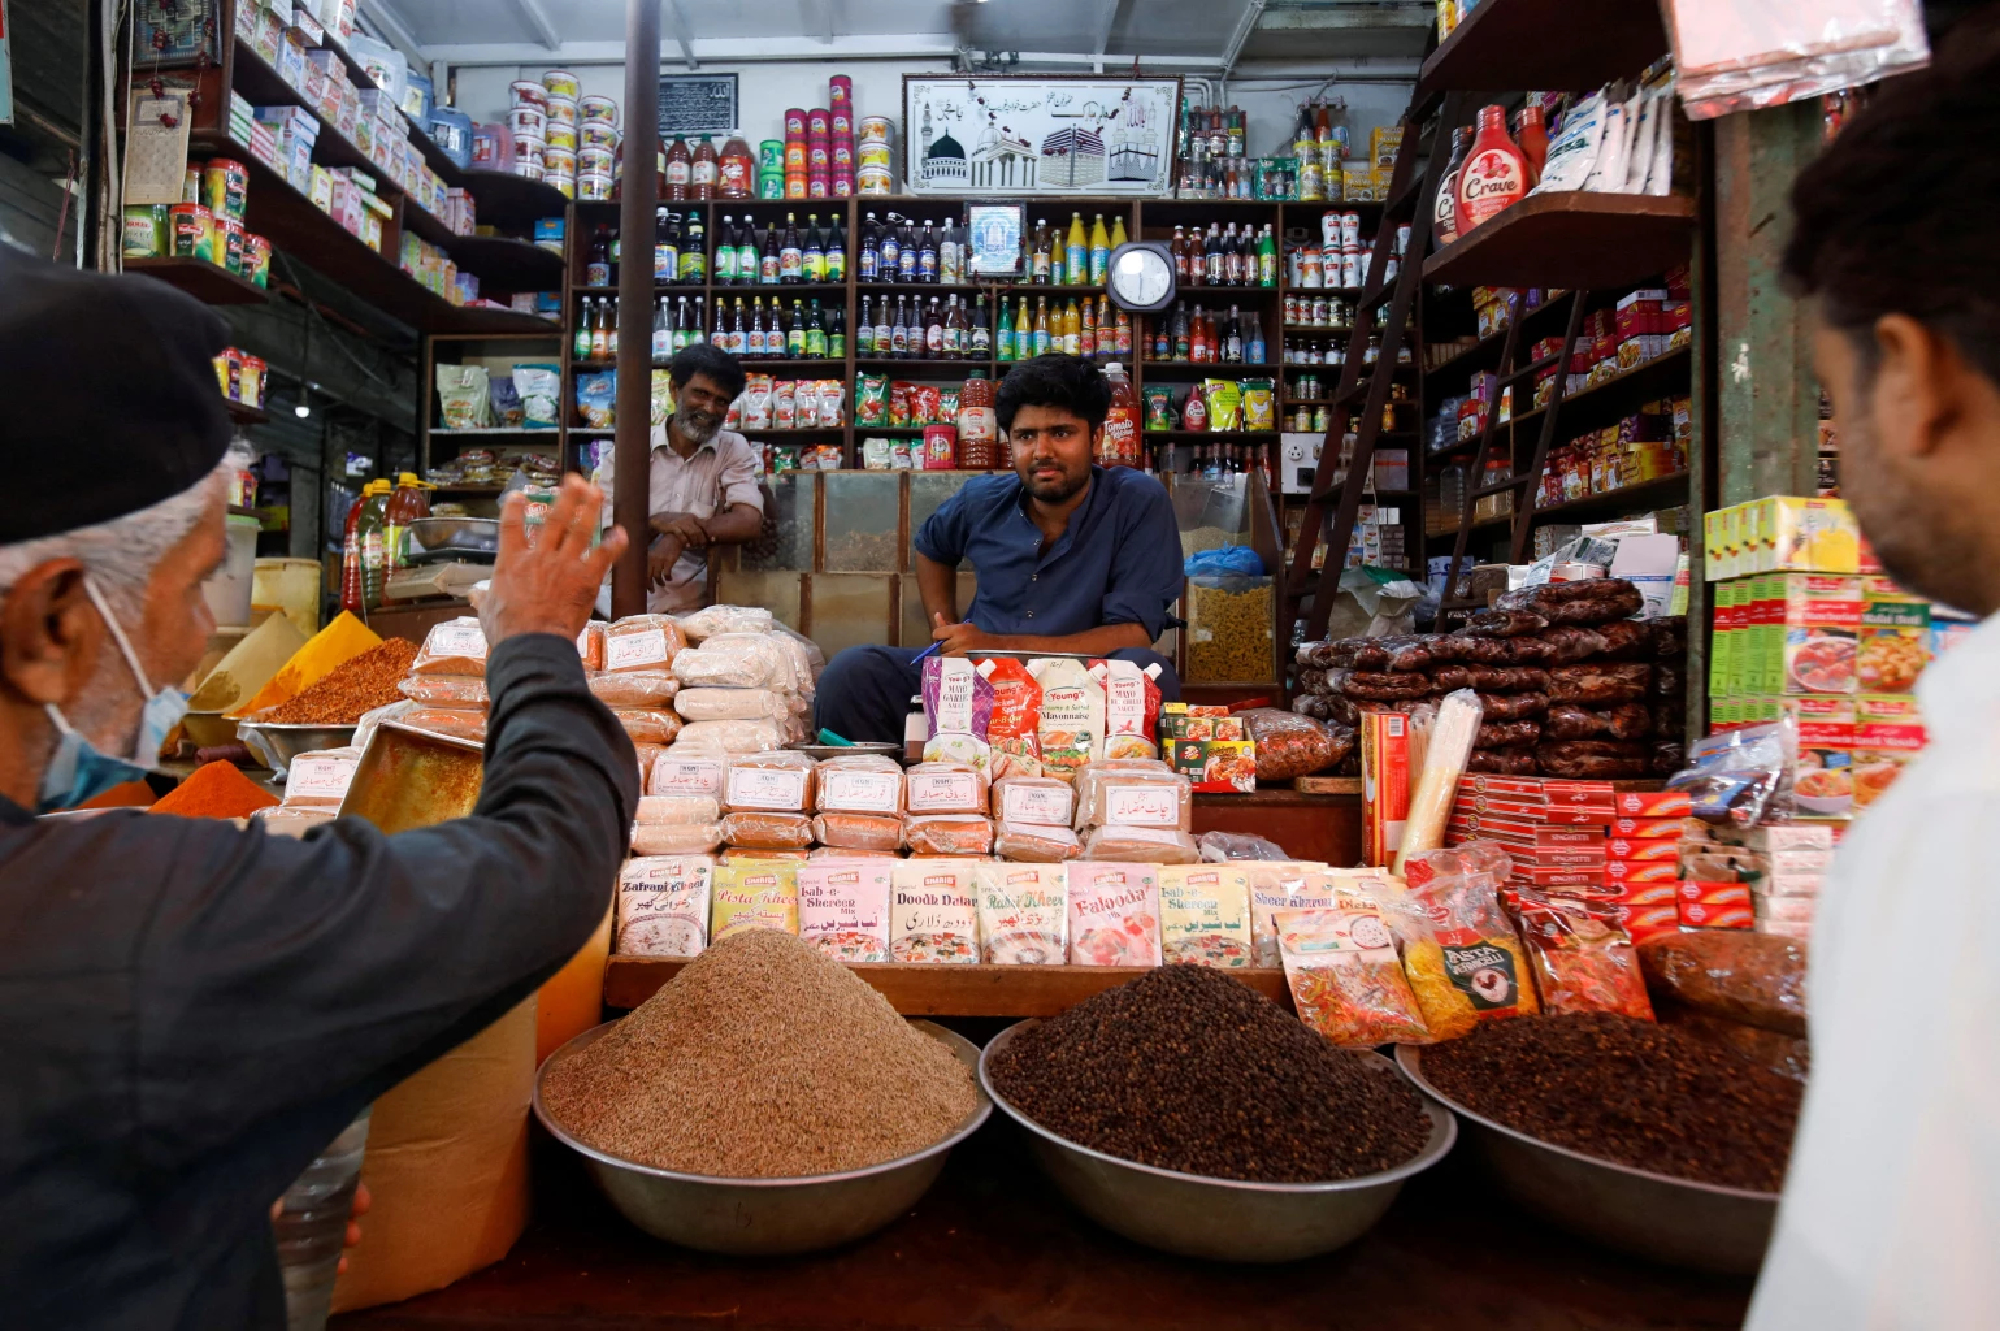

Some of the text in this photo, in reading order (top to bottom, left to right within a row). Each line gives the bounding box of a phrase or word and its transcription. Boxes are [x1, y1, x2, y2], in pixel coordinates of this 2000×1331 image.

[1466, 178, 1517, 199] Crave
[993, 685, 1024, 695] oung's
[716, 889, 753, 904] Pista
[897, 893, 938, 906] Doodh
[1075, 887, 1147, 917] Falooda
